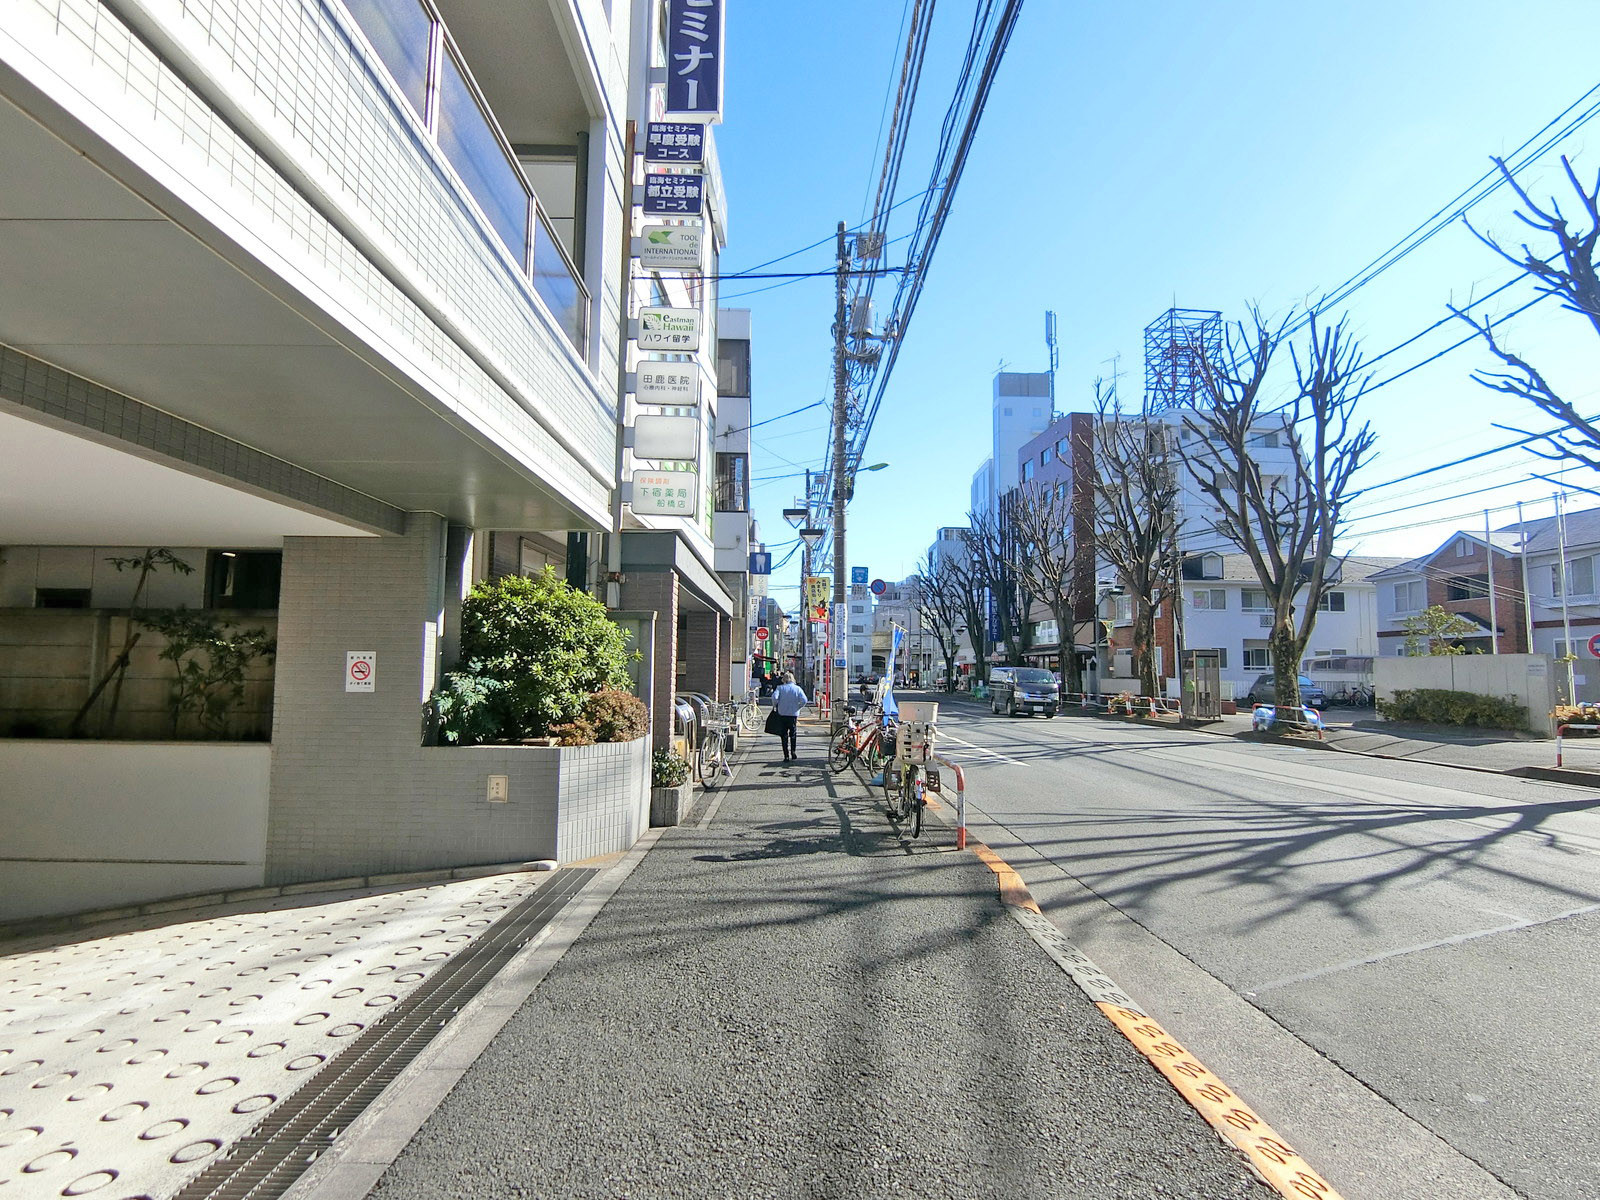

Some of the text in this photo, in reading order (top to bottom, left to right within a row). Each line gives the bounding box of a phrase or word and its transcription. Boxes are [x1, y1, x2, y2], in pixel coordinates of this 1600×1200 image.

[674, 0, 714, 110] ミナー
[651, 124, 696, 133] 臨海セミナー
[649, 133, 701, 147] 早慶受験
[657, 148, 690, 159] コース
[649, 176, 695, 185] 臨海セミナー
[647, 184, 700, 198] 都立受験
[656, 200, 688, 211] コース
[680, 234, 699, 242] TOOL
[688, 241, 699, 249] de
[644, 247, 699, 256] INTERNATIONAL
[663, 314, 695, 323] eastman
[663, 322, 694, 332] Hawaii
[643, 333, 691, 344] ハワイ留学
[643, 374, 690, 386] 田鹿医院
[640, 487, 688, 499] 下宿薬局
